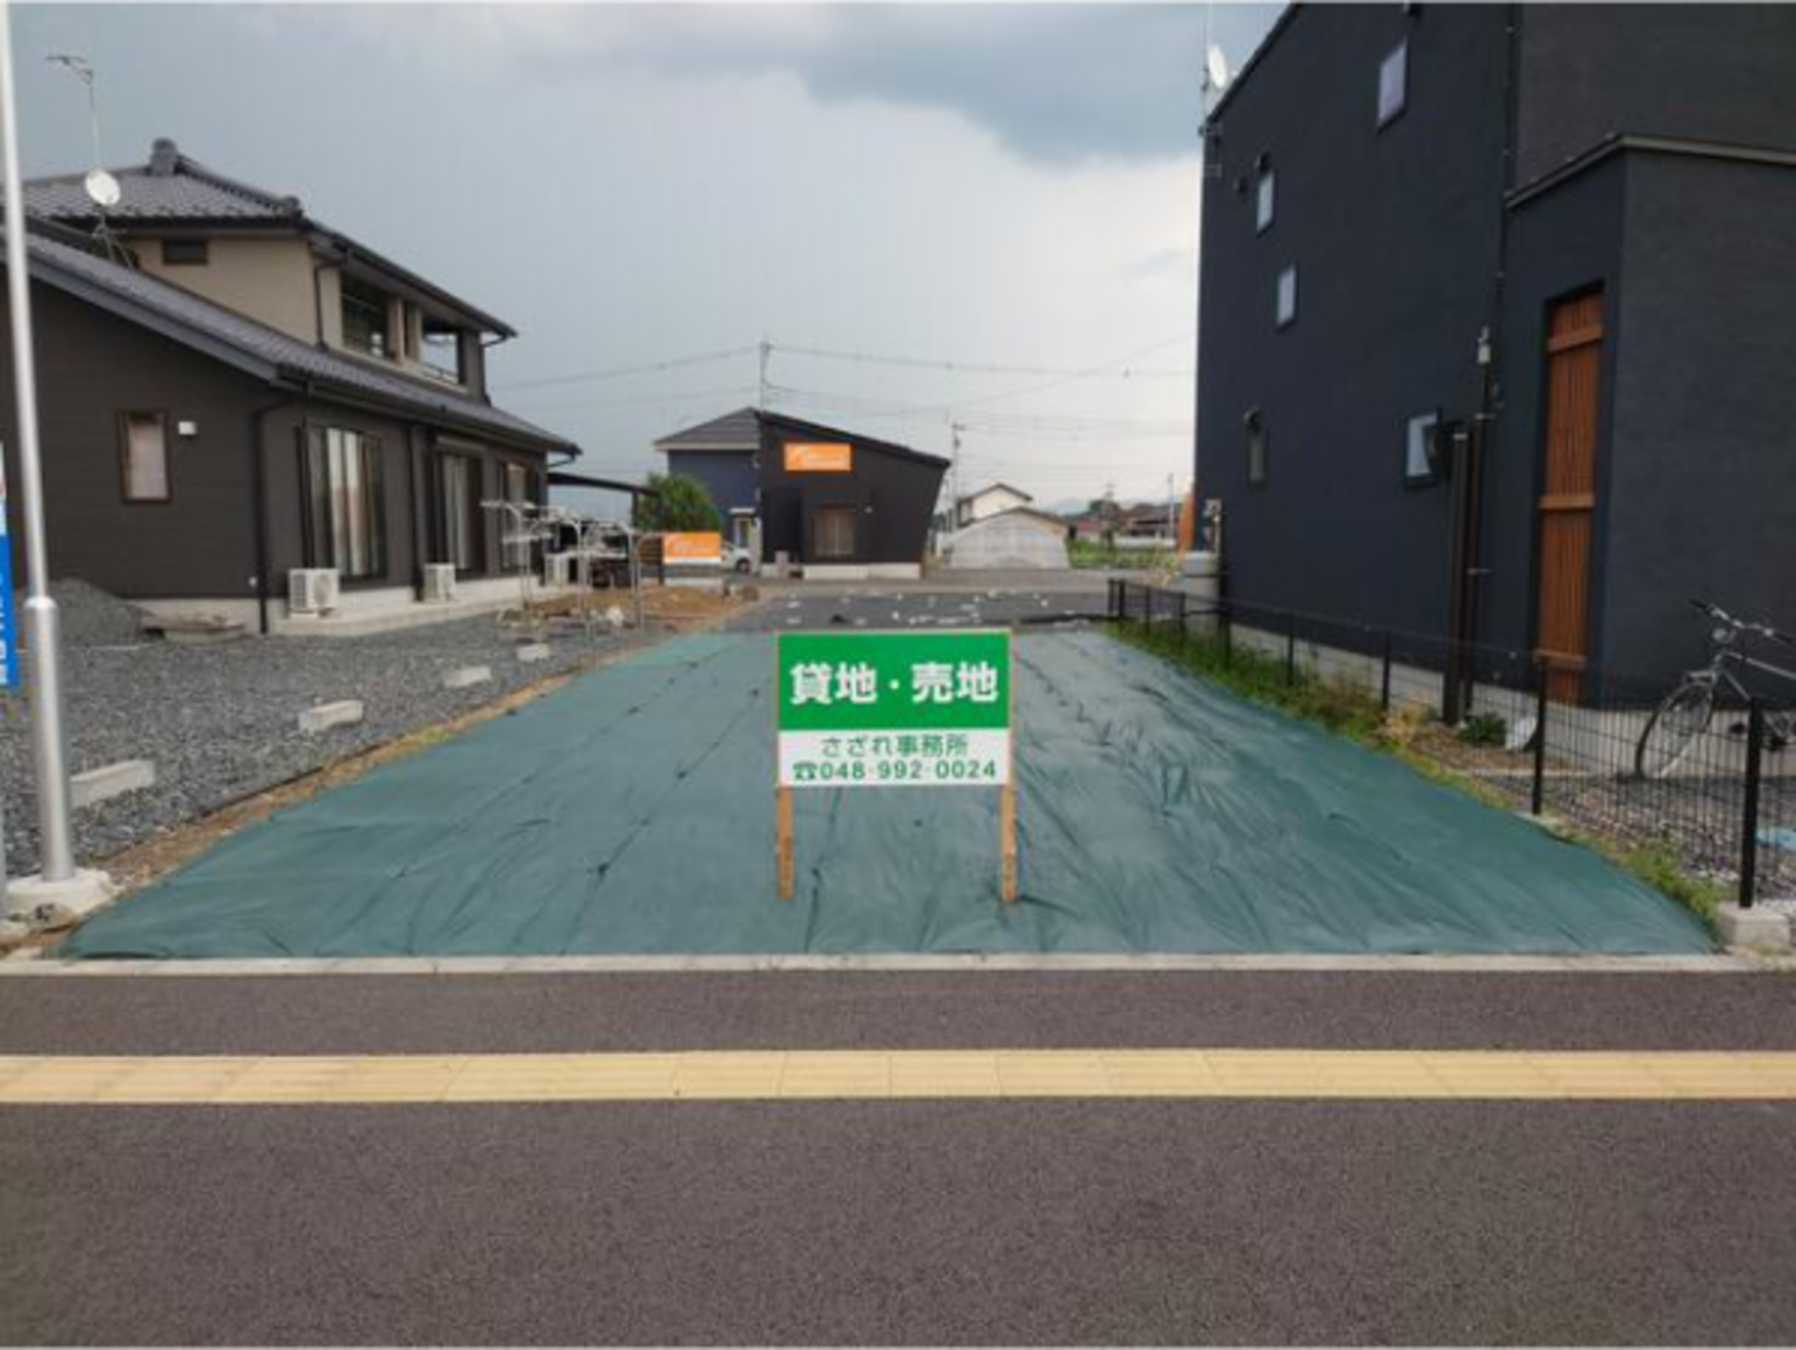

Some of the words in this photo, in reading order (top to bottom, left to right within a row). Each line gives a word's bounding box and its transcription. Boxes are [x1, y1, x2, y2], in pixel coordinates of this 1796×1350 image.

[790, 662, 999, 704] 貸地・売地
